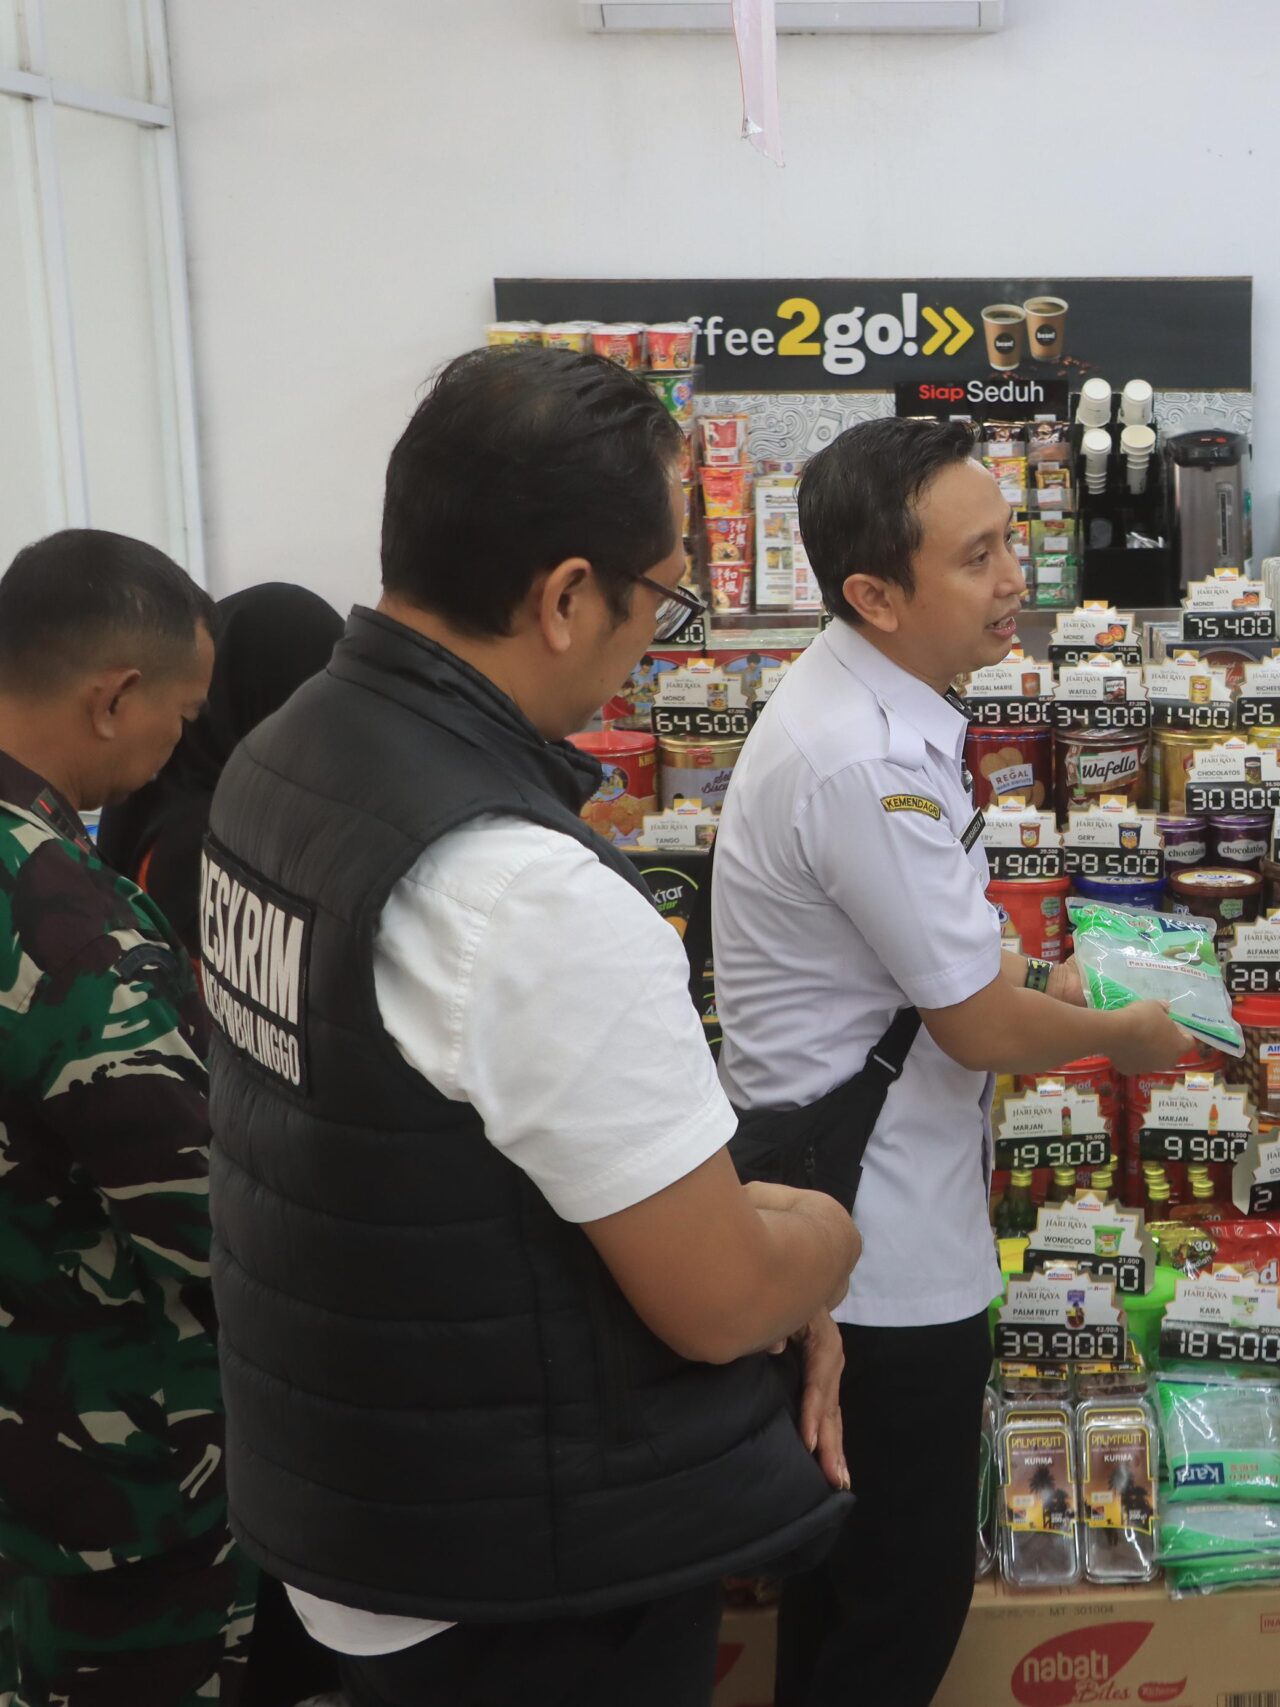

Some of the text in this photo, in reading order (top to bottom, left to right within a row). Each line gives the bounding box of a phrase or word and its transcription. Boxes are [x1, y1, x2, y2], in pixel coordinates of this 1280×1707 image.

[918, 381, 1045, 402] Siap Seduh
[1190, 617, 1272, 637] 75 400
[656, 713, 748, 734] 64 500
[1057, 706, 1146, 727] 34 900
[1178, 706, 1230, 728] 400
[1241, 704, 1275, 725] 26
[995, 769, 1030, 785] REGAL
[1082, 755, 1138, 782] Wafello
[885, 798, 940, 818] KEMENDAGRI
[1193, 788, 1225, 810] 30
[1006, 855, 1060, 877] 900
[1064, 853, 1159, 876] 28 500
[1231, 968, 1269, 991] 28
[1012, 1108, 1053, 1118] HARI RAYA
[1158, 1115, 1189, 1123] MARJAN
[1013, 1123, 1044, 1131] MARJAN
[1013, 1140, 1105, 1168] 19 900
[1164, 1136, 1183, 1160] 9
[1043, 1236, 1092, 1246] WONOCOCO
[1015, 1291, 1060, 1301] HARI RAYA
[1183, 1289, 1227, 1299] HARI RAYA
[1199, 1306, 1221, 1315] KARA
[1003, 1331, 1118, 1358] 39.900
[1179, 1330, 1209, 1357] 18
[1024, 1457, 1053, 1466] KURMA
[1104, 1454, 1134, 1463] KURMA
[1023, 1649, 1109, 1683] nabati
